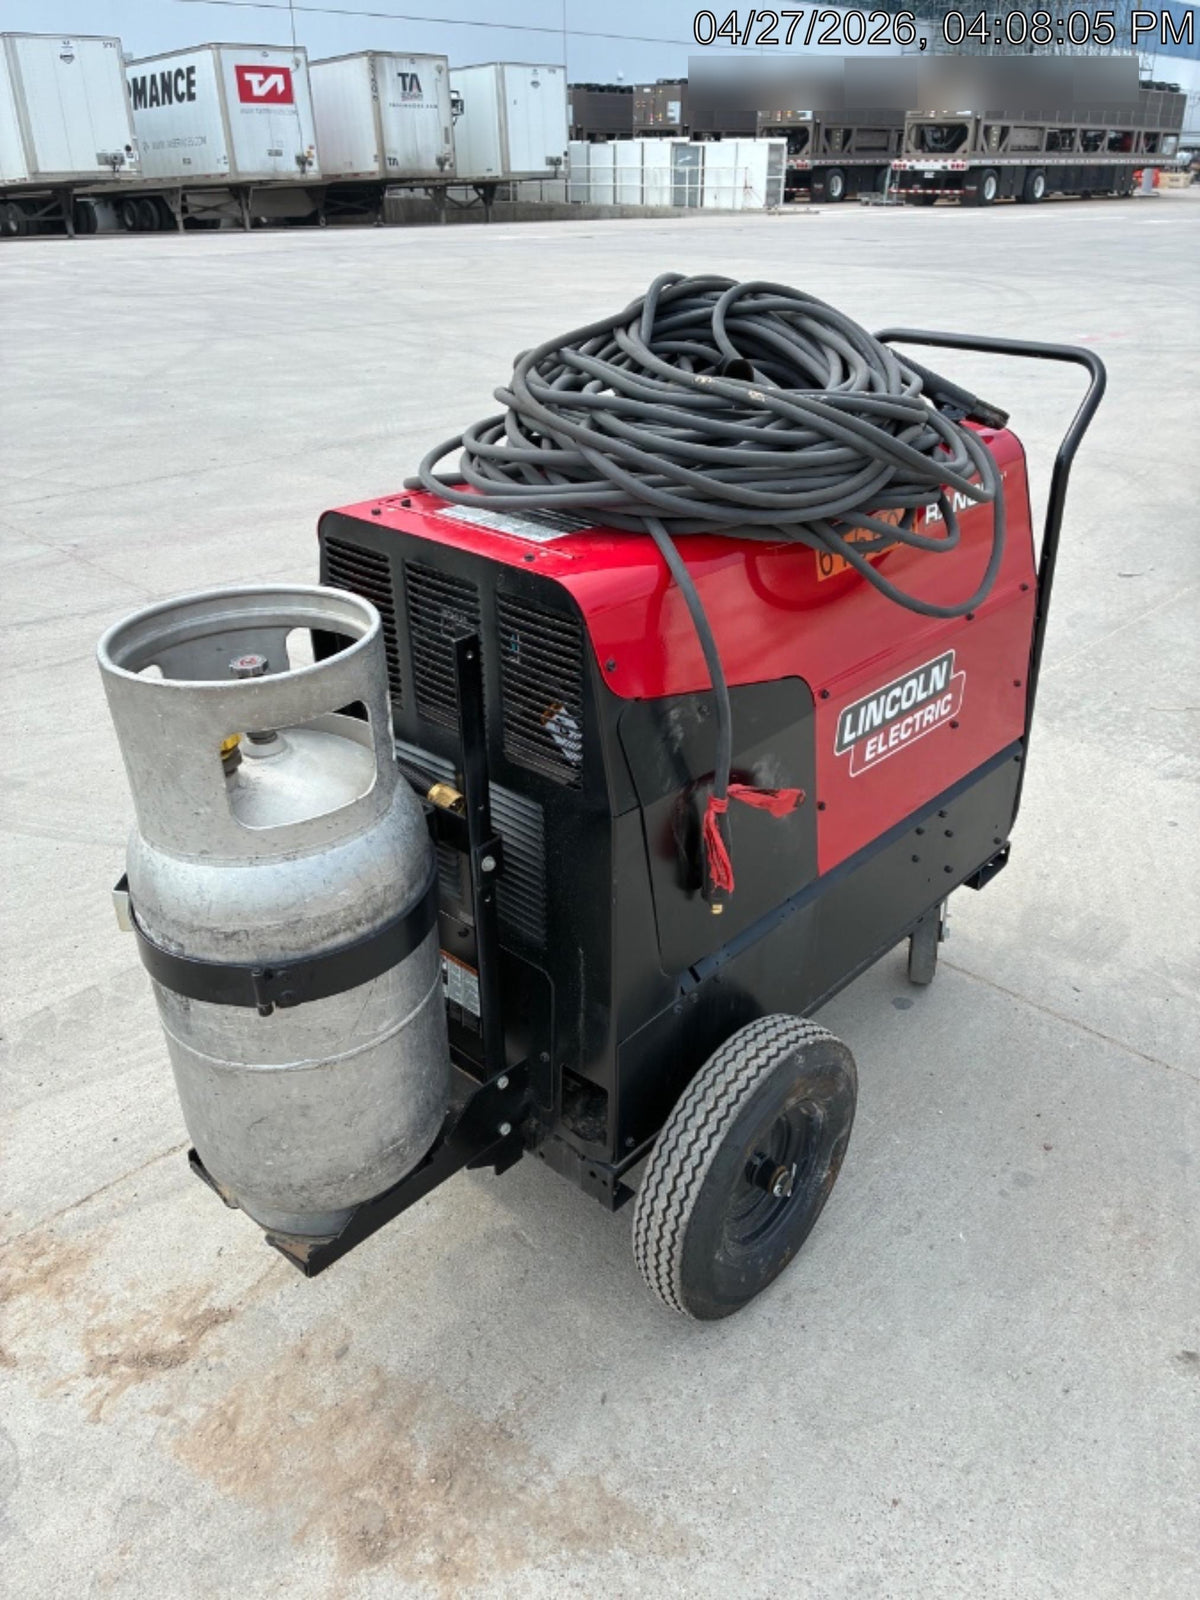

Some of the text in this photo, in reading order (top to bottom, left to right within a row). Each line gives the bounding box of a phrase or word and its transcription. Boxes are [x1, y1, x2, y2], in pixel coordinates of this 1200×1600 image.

[397, 72, 422, 93] TA
[843, 660, 949, 745] LINCOLN
[864, 692, 953, 762] ELECTRIC
